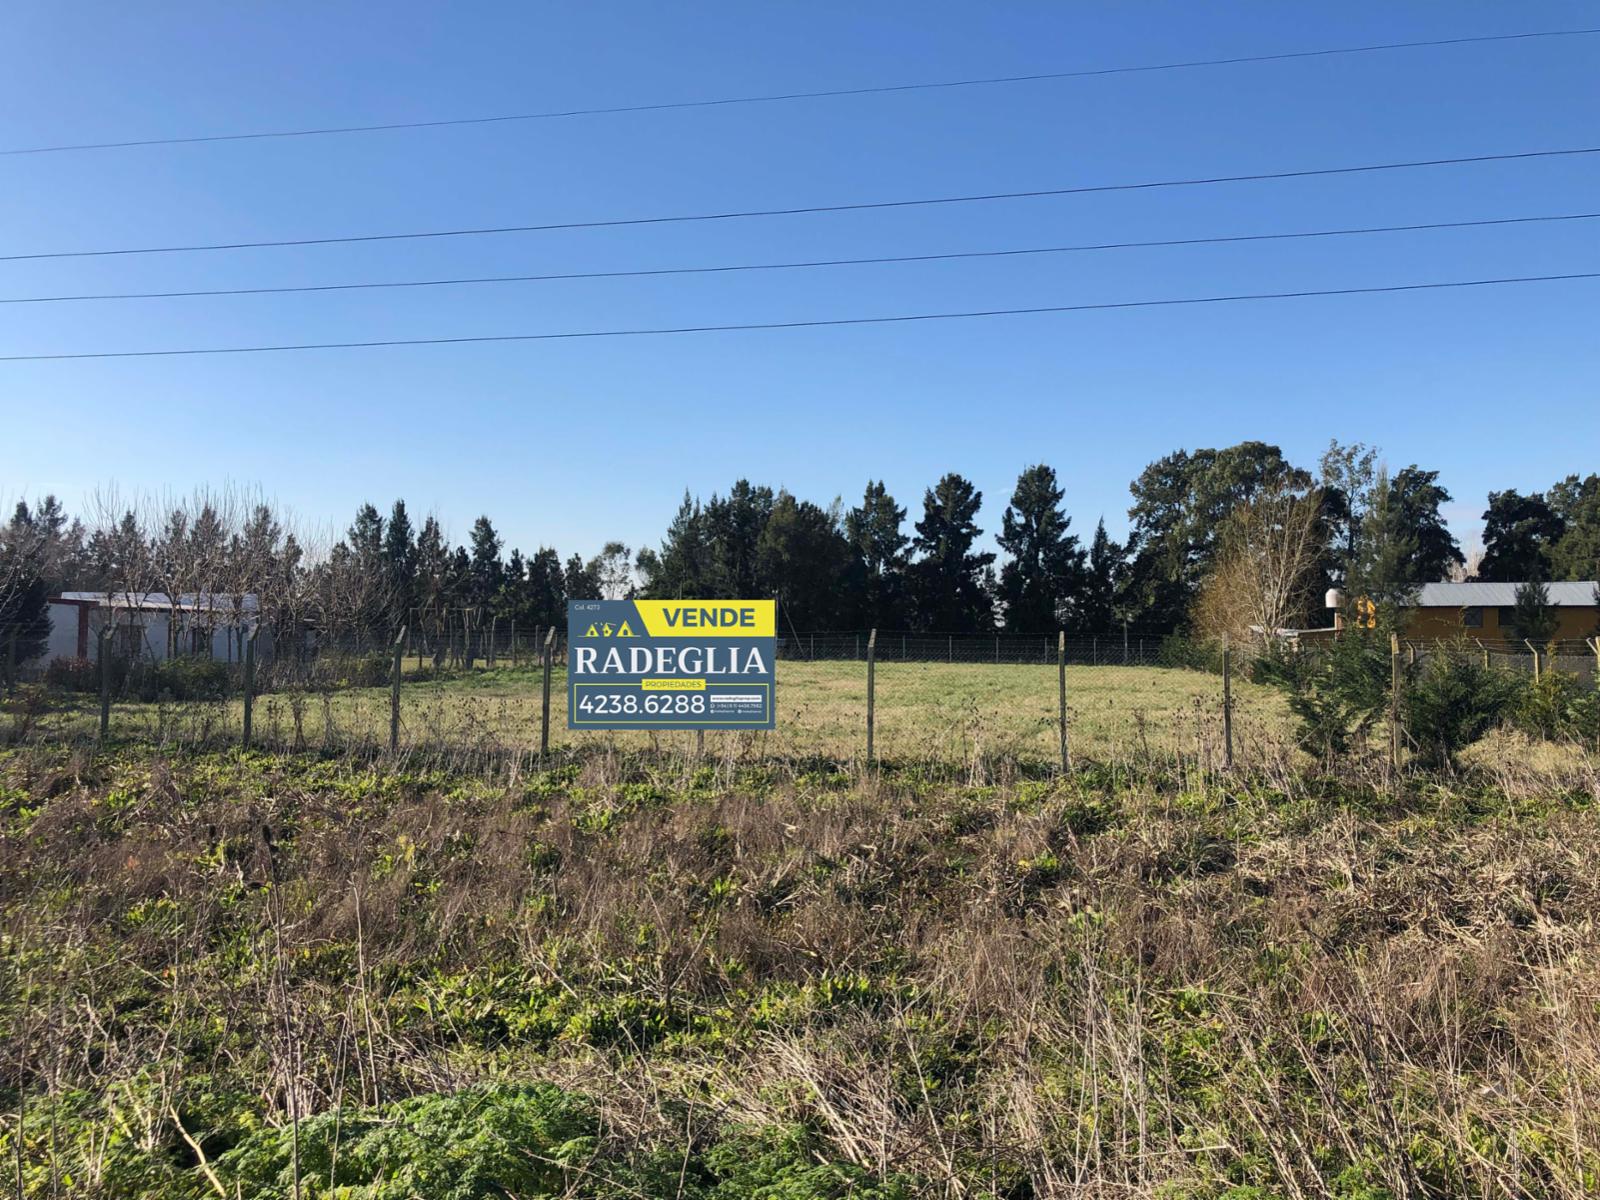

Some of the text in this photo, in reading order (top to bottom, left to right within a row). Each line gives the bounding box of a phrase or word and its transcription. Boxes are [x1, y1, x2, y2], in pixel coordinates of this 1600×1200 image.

[662, 608, 756, 627] VENDE
[574, 647, 769, 674] RADEGLIA
[579, 695, 705, 714] 4238.6288
